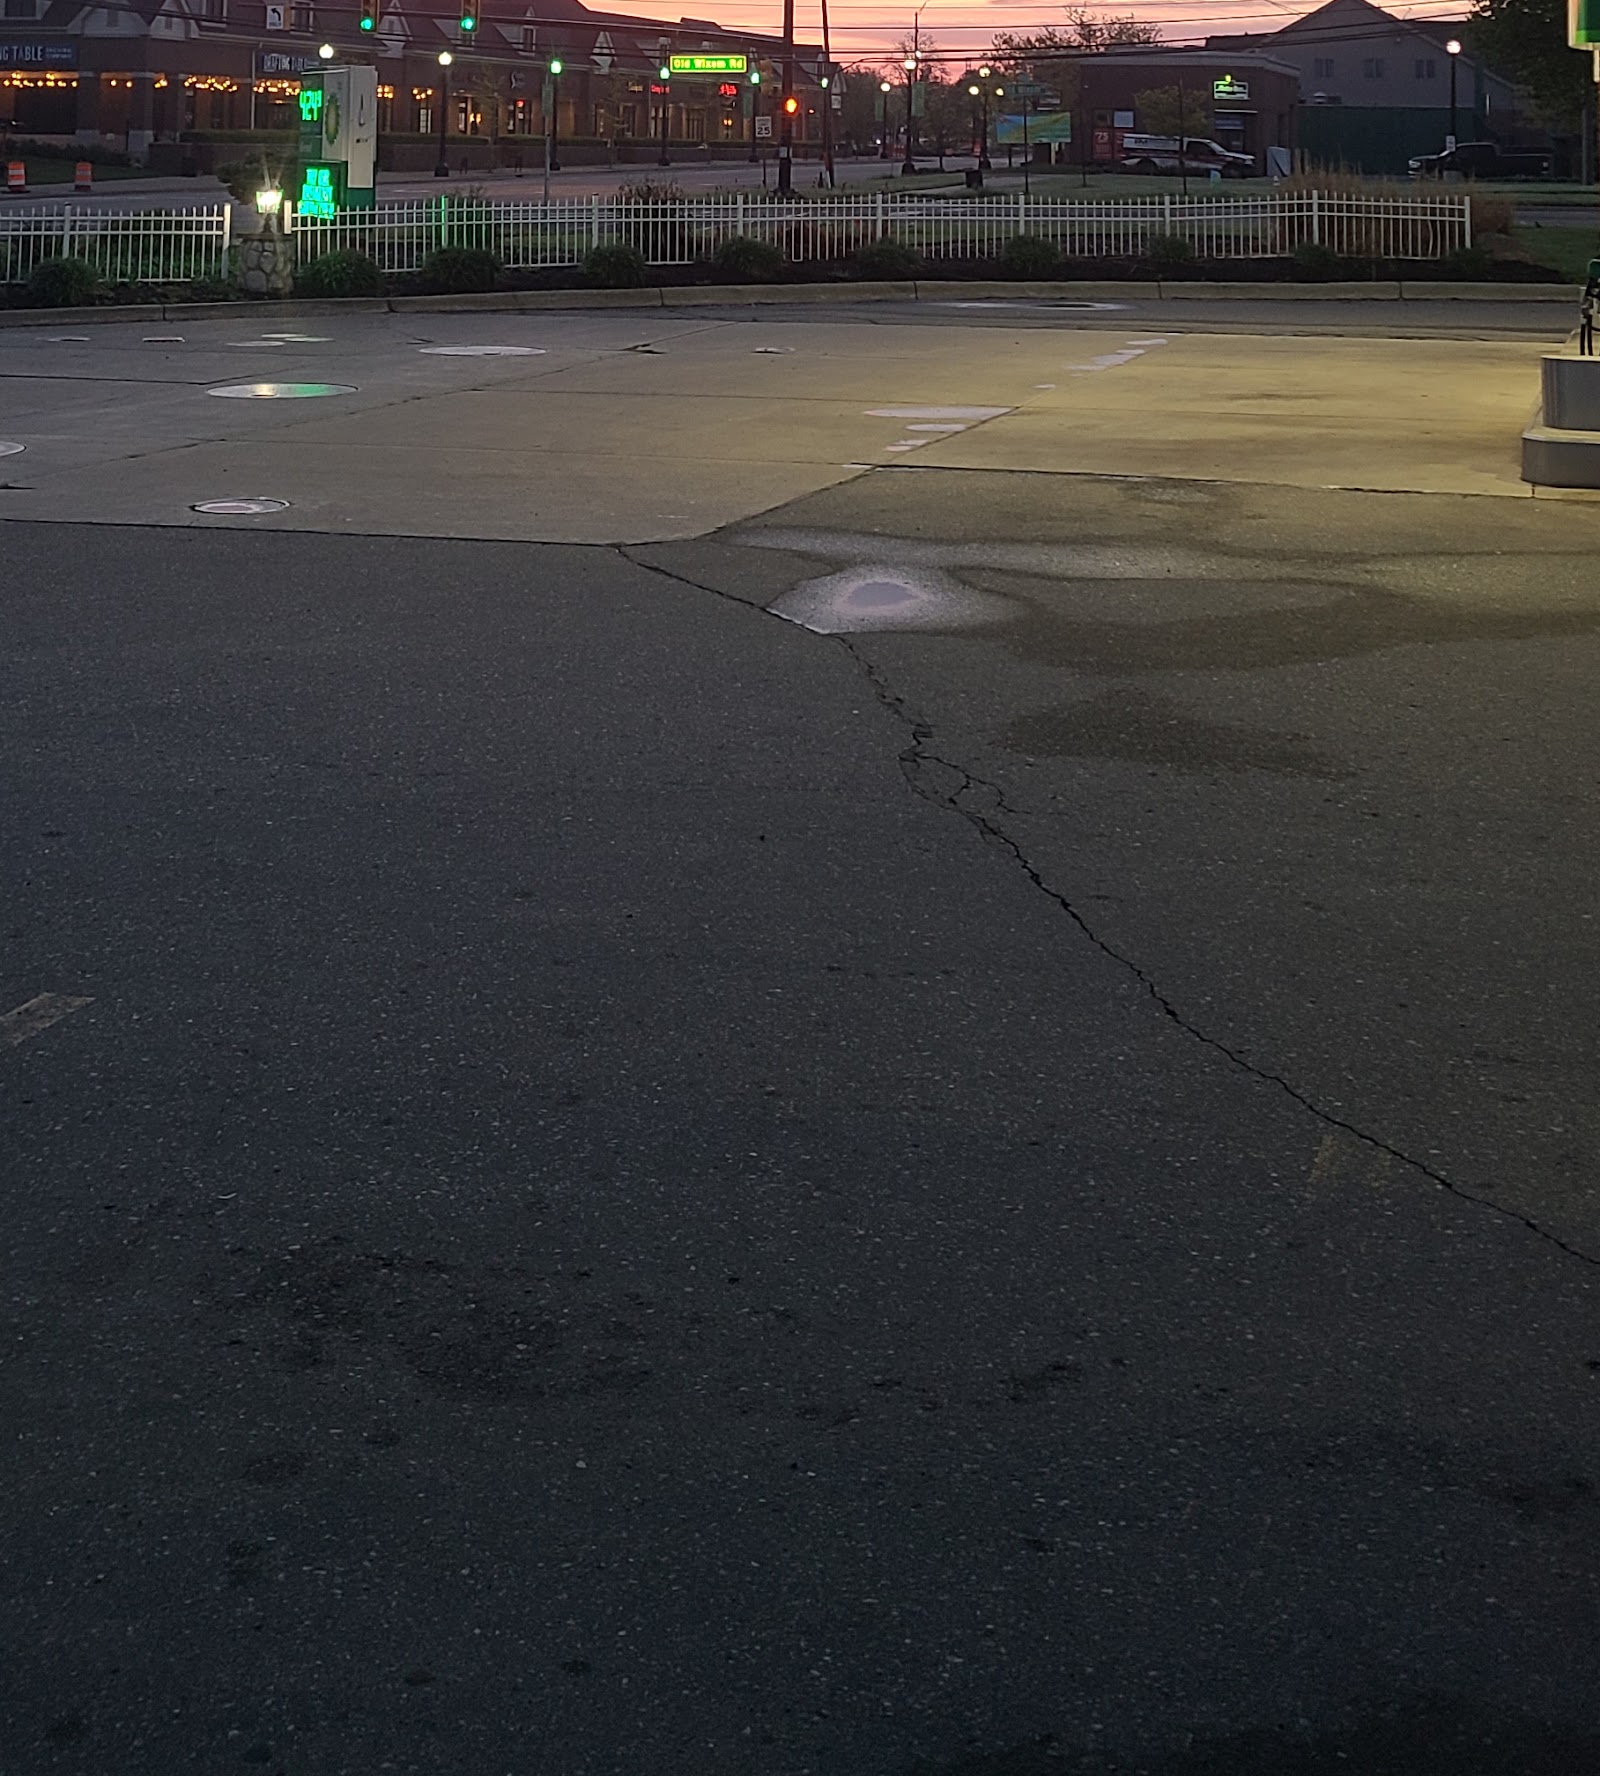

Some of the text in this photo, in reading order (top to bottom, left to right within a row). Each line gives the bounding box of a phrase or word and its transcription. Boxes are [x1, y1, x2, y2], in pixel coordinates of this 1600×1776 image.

[11, 46, 43, 61] TABLE
[673, 58, 743, 69] Old Wixom Rd
[757, 126, 771, 135] 25
